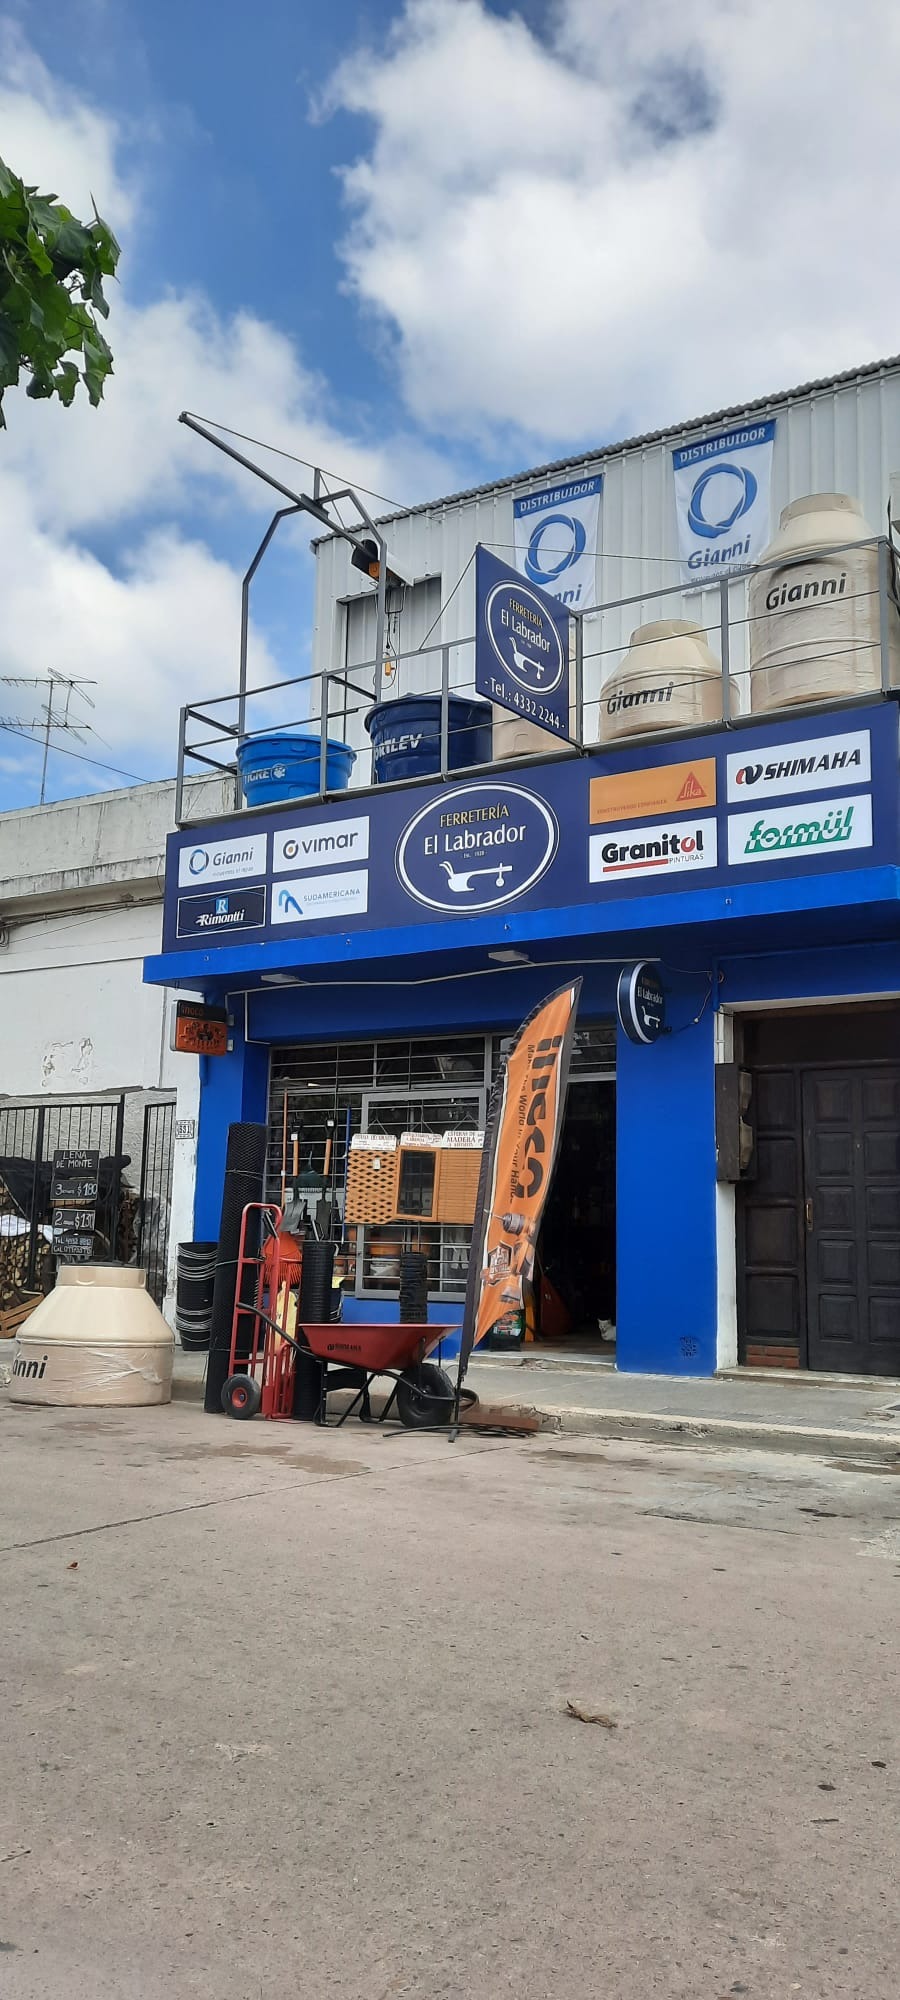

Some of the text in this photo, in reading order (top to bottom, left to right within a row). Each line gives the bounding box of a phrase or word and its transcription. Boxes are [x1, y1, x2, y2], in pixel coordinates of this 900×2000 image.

[680, 428, 766, 462] DISTRIBUIDOR
[520, 481, 595, 512] DISTRIBUIDOR
[687, 534, 751, 570] Gianni
[766, 572, 847, 611] Gianni
[509, 598, 543, 629] FERRETERÍA
[501, 608, 551, 653] El Labrador
[513, 691, 537, 716] 4332
[538, 705, 560, 729] 2244
[607, 681, 674, 715] Gianni
[763, 749, 862, 781] SHIMAHA
[680, 780, 703, 799] Sika
[440, 803, 509, 828] FERRETERÍA
[424, 823, 526, 856] El Labrador
[601, 830, 704, 864] Granitol
[213, 847, 254, 866] Gianni
[668, 853, 704, 865] PINTURAS
[304, 888, 361, 902] SUDAMERICANA
[196, 909, 246, 927] Rimontti
[56, 1159, 93, 1168] DE MONTE
[55, 1183, 63, 1195] 3
[54, 1211, 63, 1226] 2
